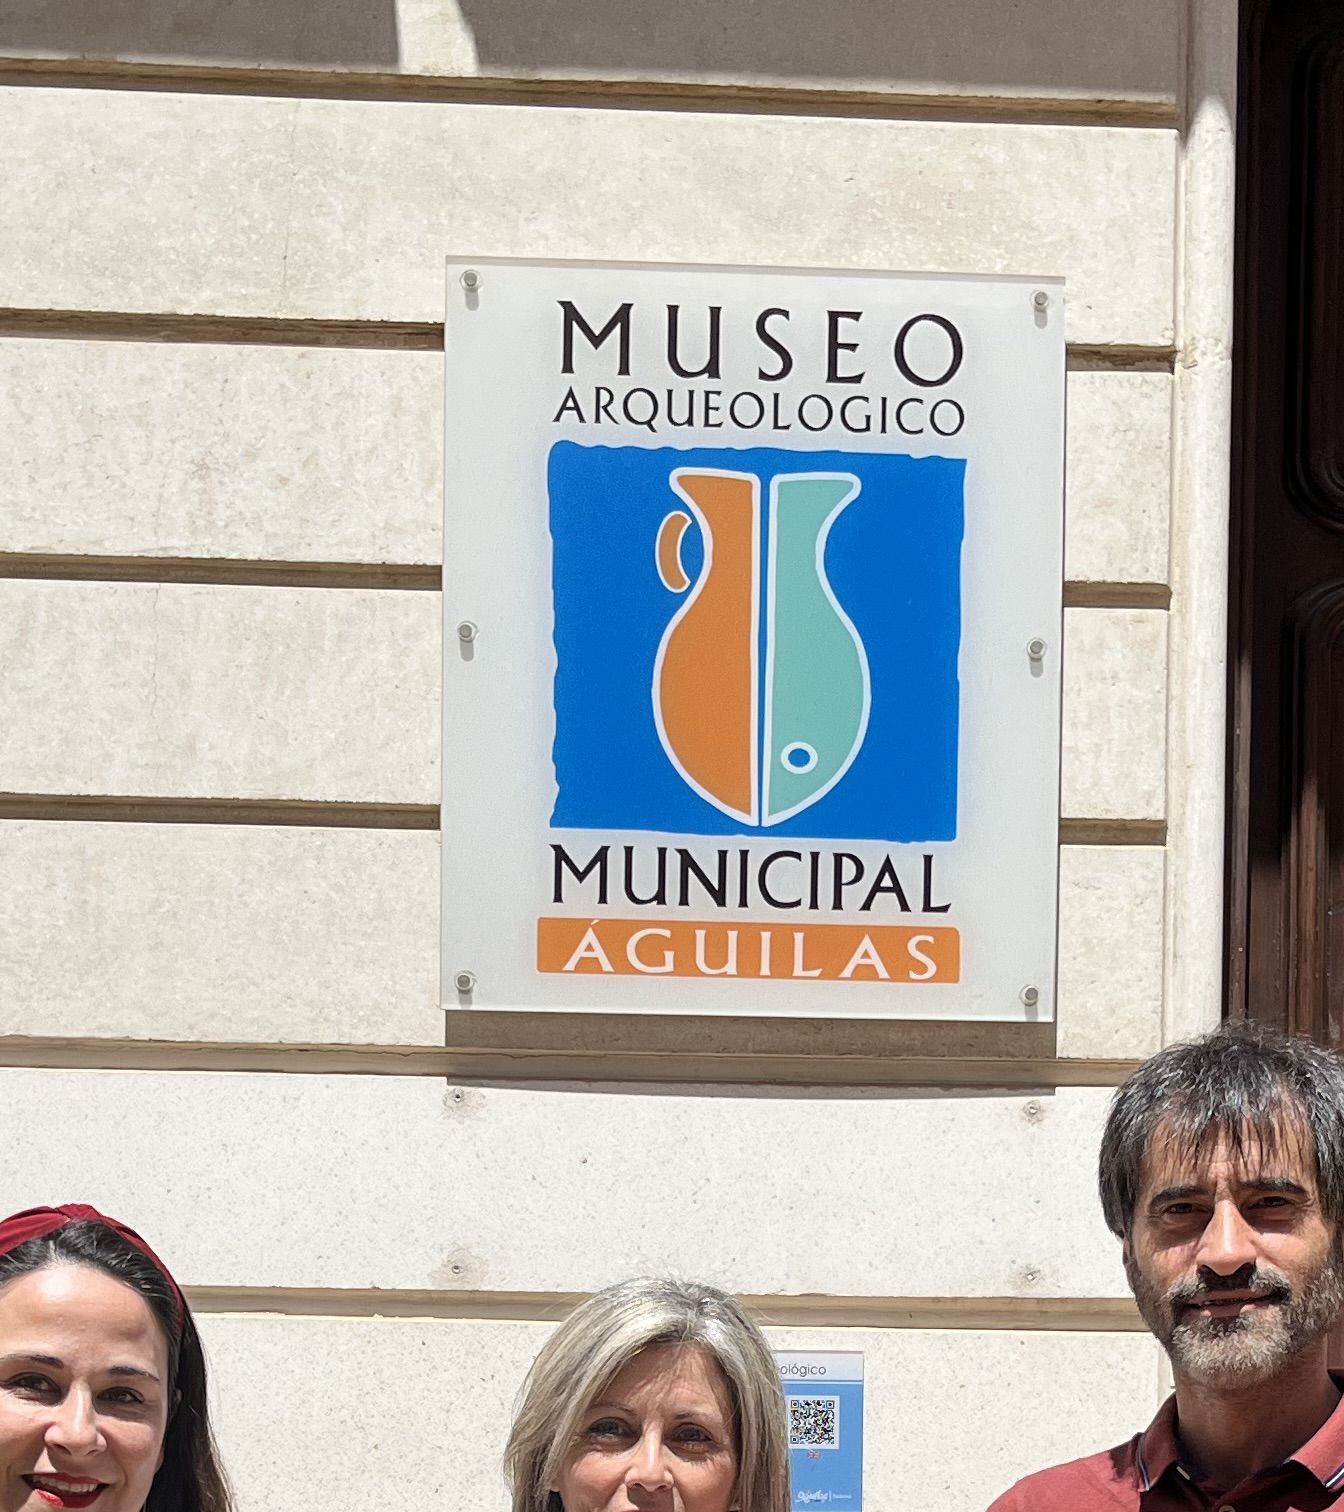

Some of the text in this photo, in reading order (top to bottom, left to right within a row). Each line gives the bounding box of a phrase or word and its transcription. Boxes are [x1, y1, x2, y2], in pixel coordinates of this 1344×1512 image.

[557, 300, 964, 387] MUSEO
[552, 386, 966, 436] ARQUEOLOGICO
[549, 844, 952, 914] MUNICIPAL
[562, 919, 938, 980] ÁGUILAS
[777, 1362, 827, 1378] ológico
